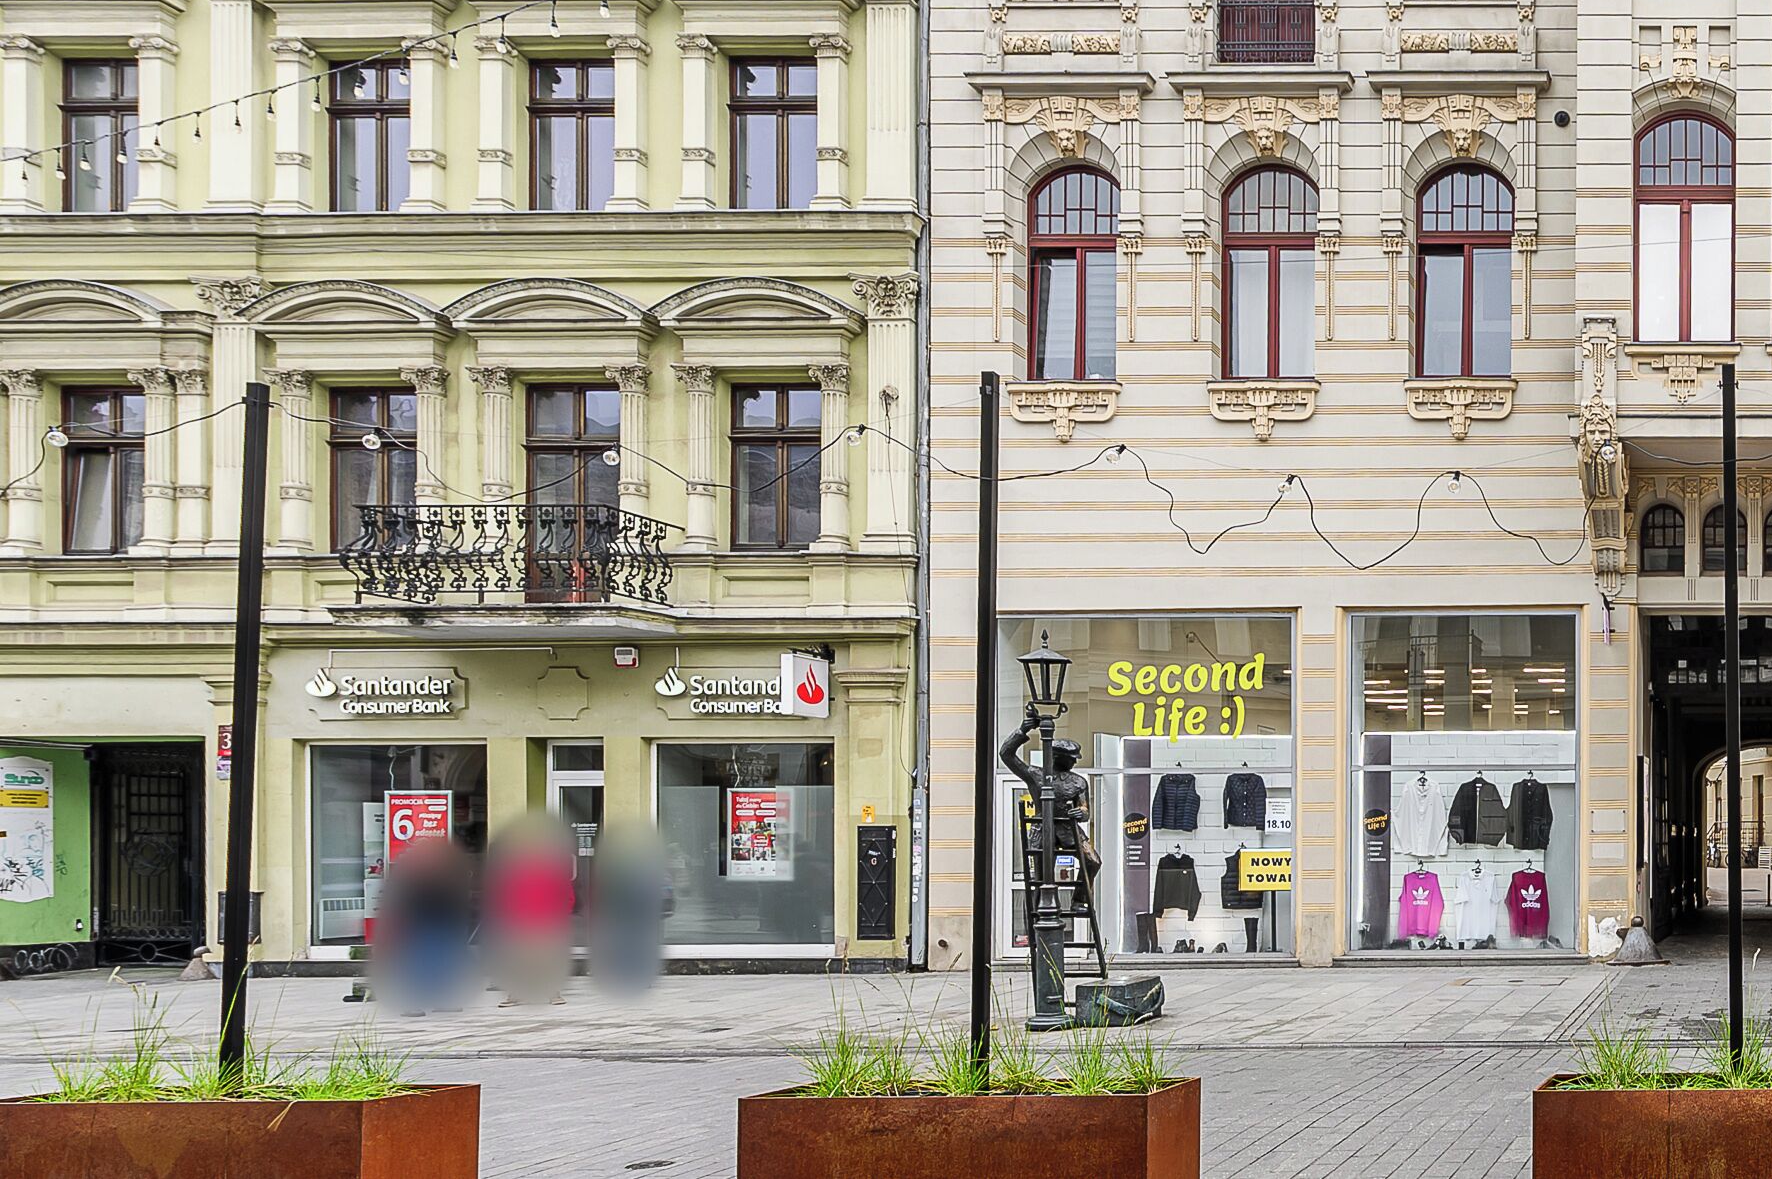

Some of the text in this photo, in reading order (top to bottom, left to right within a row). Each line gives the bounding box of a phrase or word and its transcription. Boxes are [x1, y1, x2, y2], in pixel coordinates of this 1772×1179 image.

[1107, 652, 1265, 697] Second
[340, 676, 453, 695] Santander
[689, 675, 782, 696] Santand
[1133, 696, 1208, 743] Life
[392, 809, 414, 840] 6
[1267, 820, 1291, 829] 18.10
[1251, 858, 1291, 866] NOWY
[1522, 901, 1541, 909] adidas
